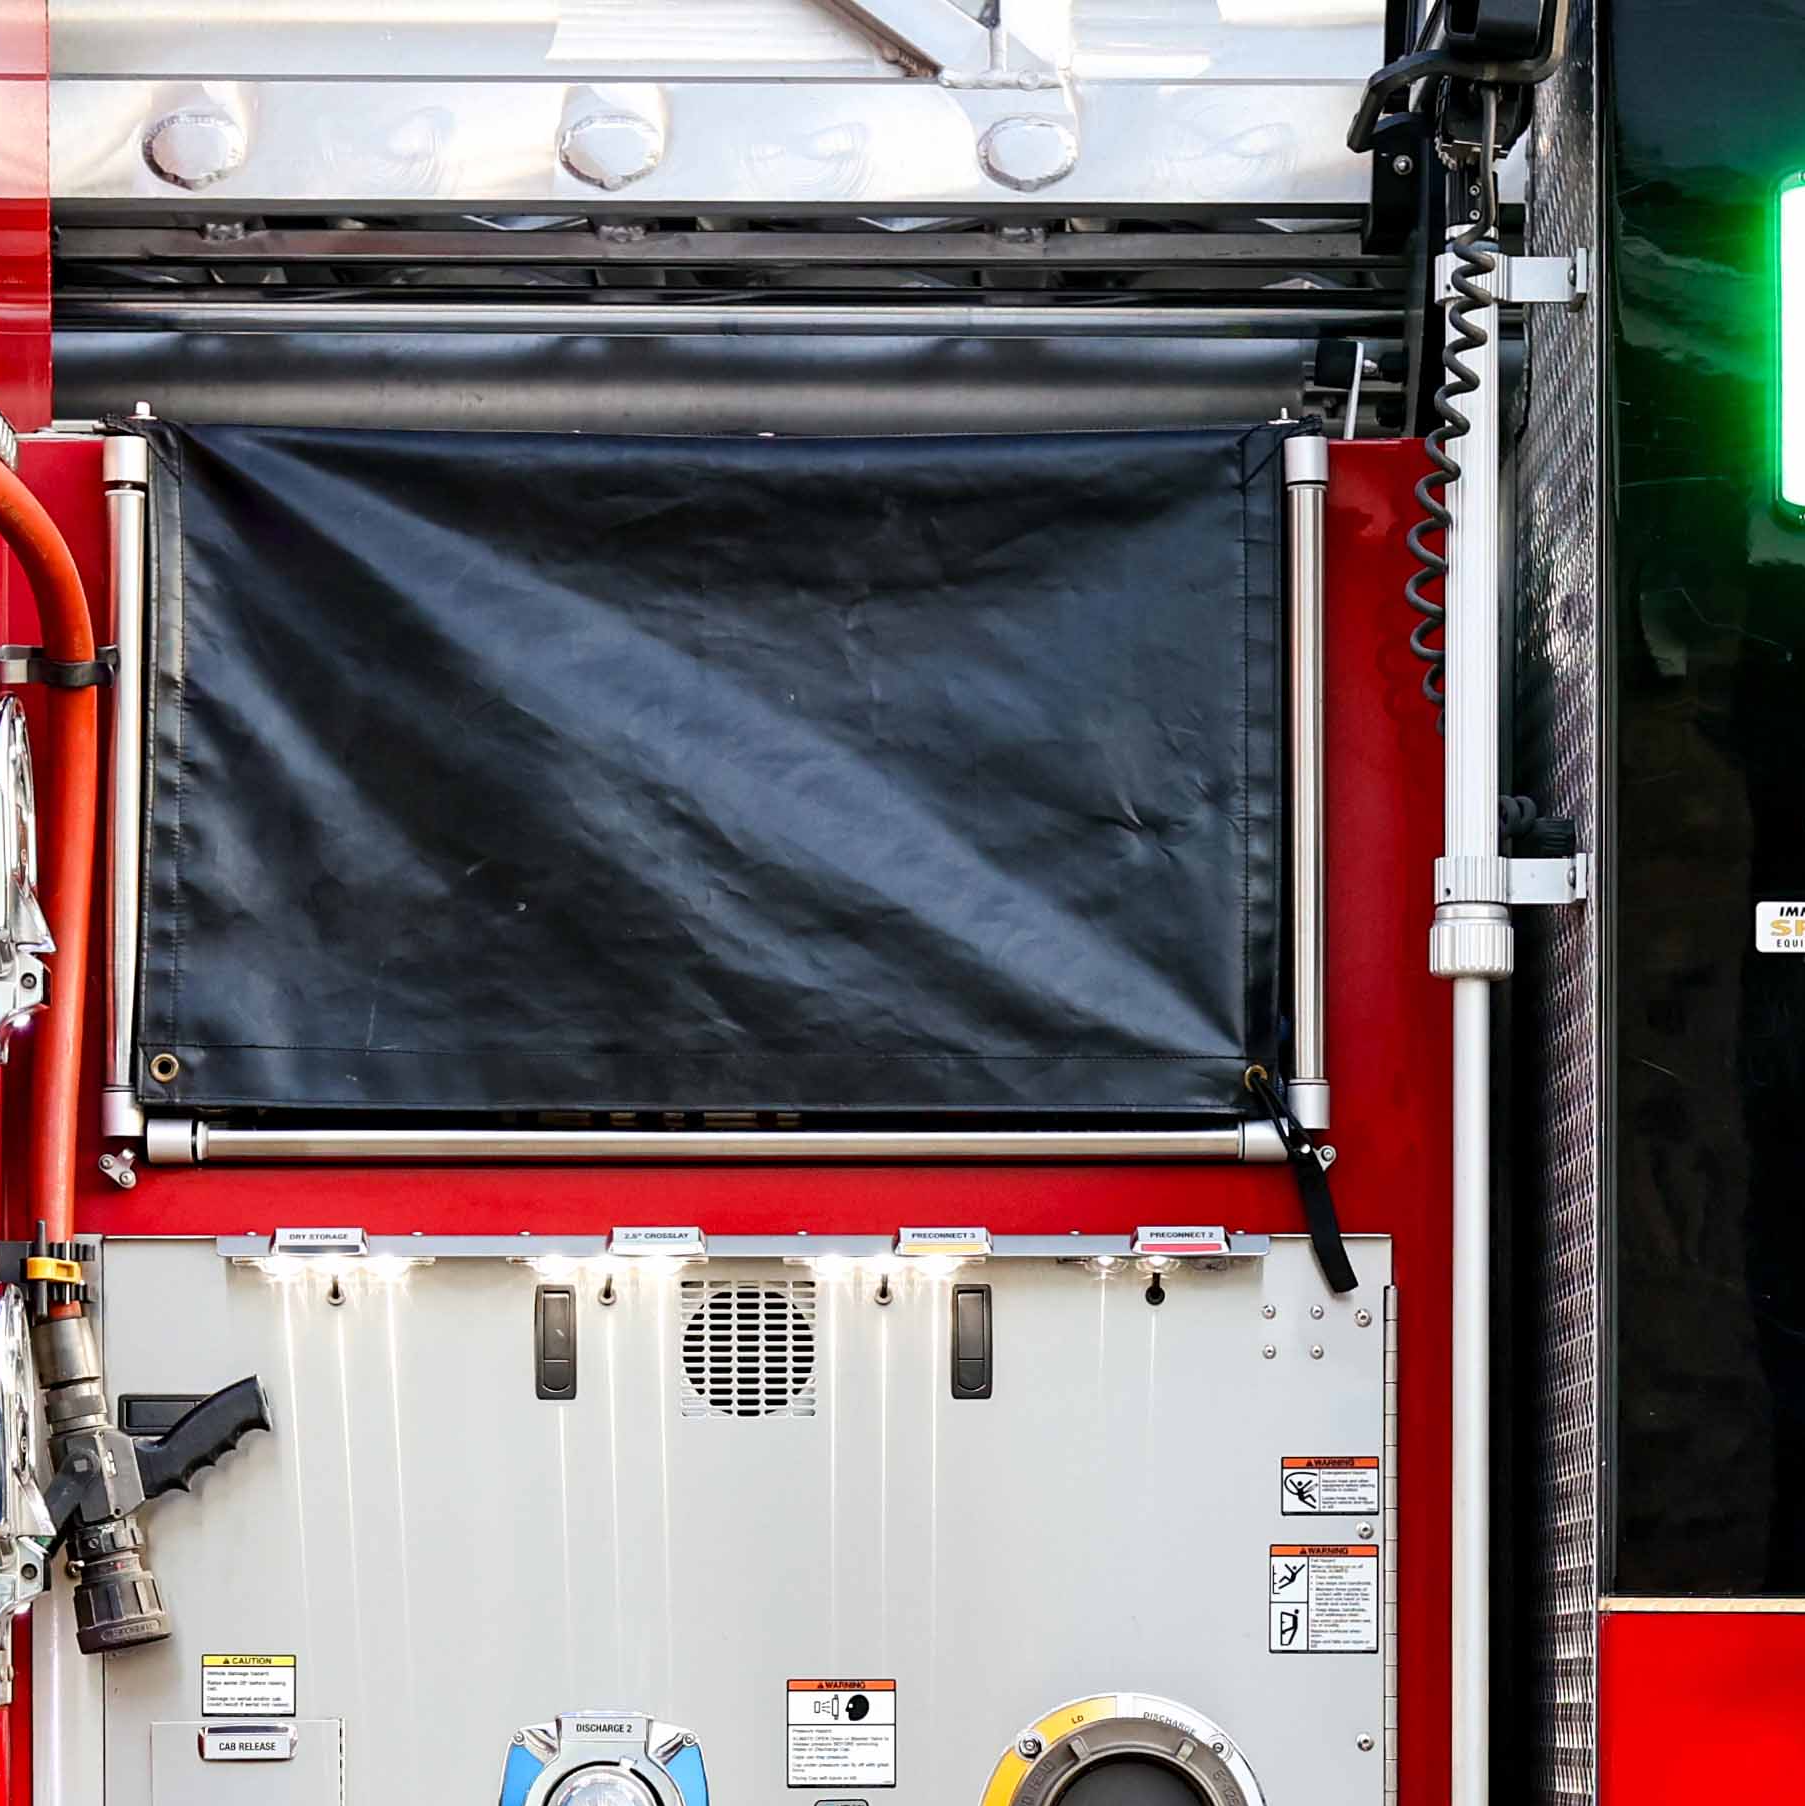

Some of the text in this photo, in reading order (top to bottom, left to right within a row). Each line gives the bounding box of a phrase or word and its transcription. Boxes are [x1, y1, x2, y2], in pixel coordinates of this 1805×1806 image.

[1308, 1547, 1348, 1555] WARNING
[232, 1657, 272, 1665] CAUTION
[825, 1681, 866, 1689] WARNING
[1071, 1714, 1084, 1725] LD
[1143, 1711, 1196, 1736] DISCHARGE
[576, 1723, 632, 1733] DISCHARGE 2
[218, 1742, 276, 1751] CAB RELEASE
